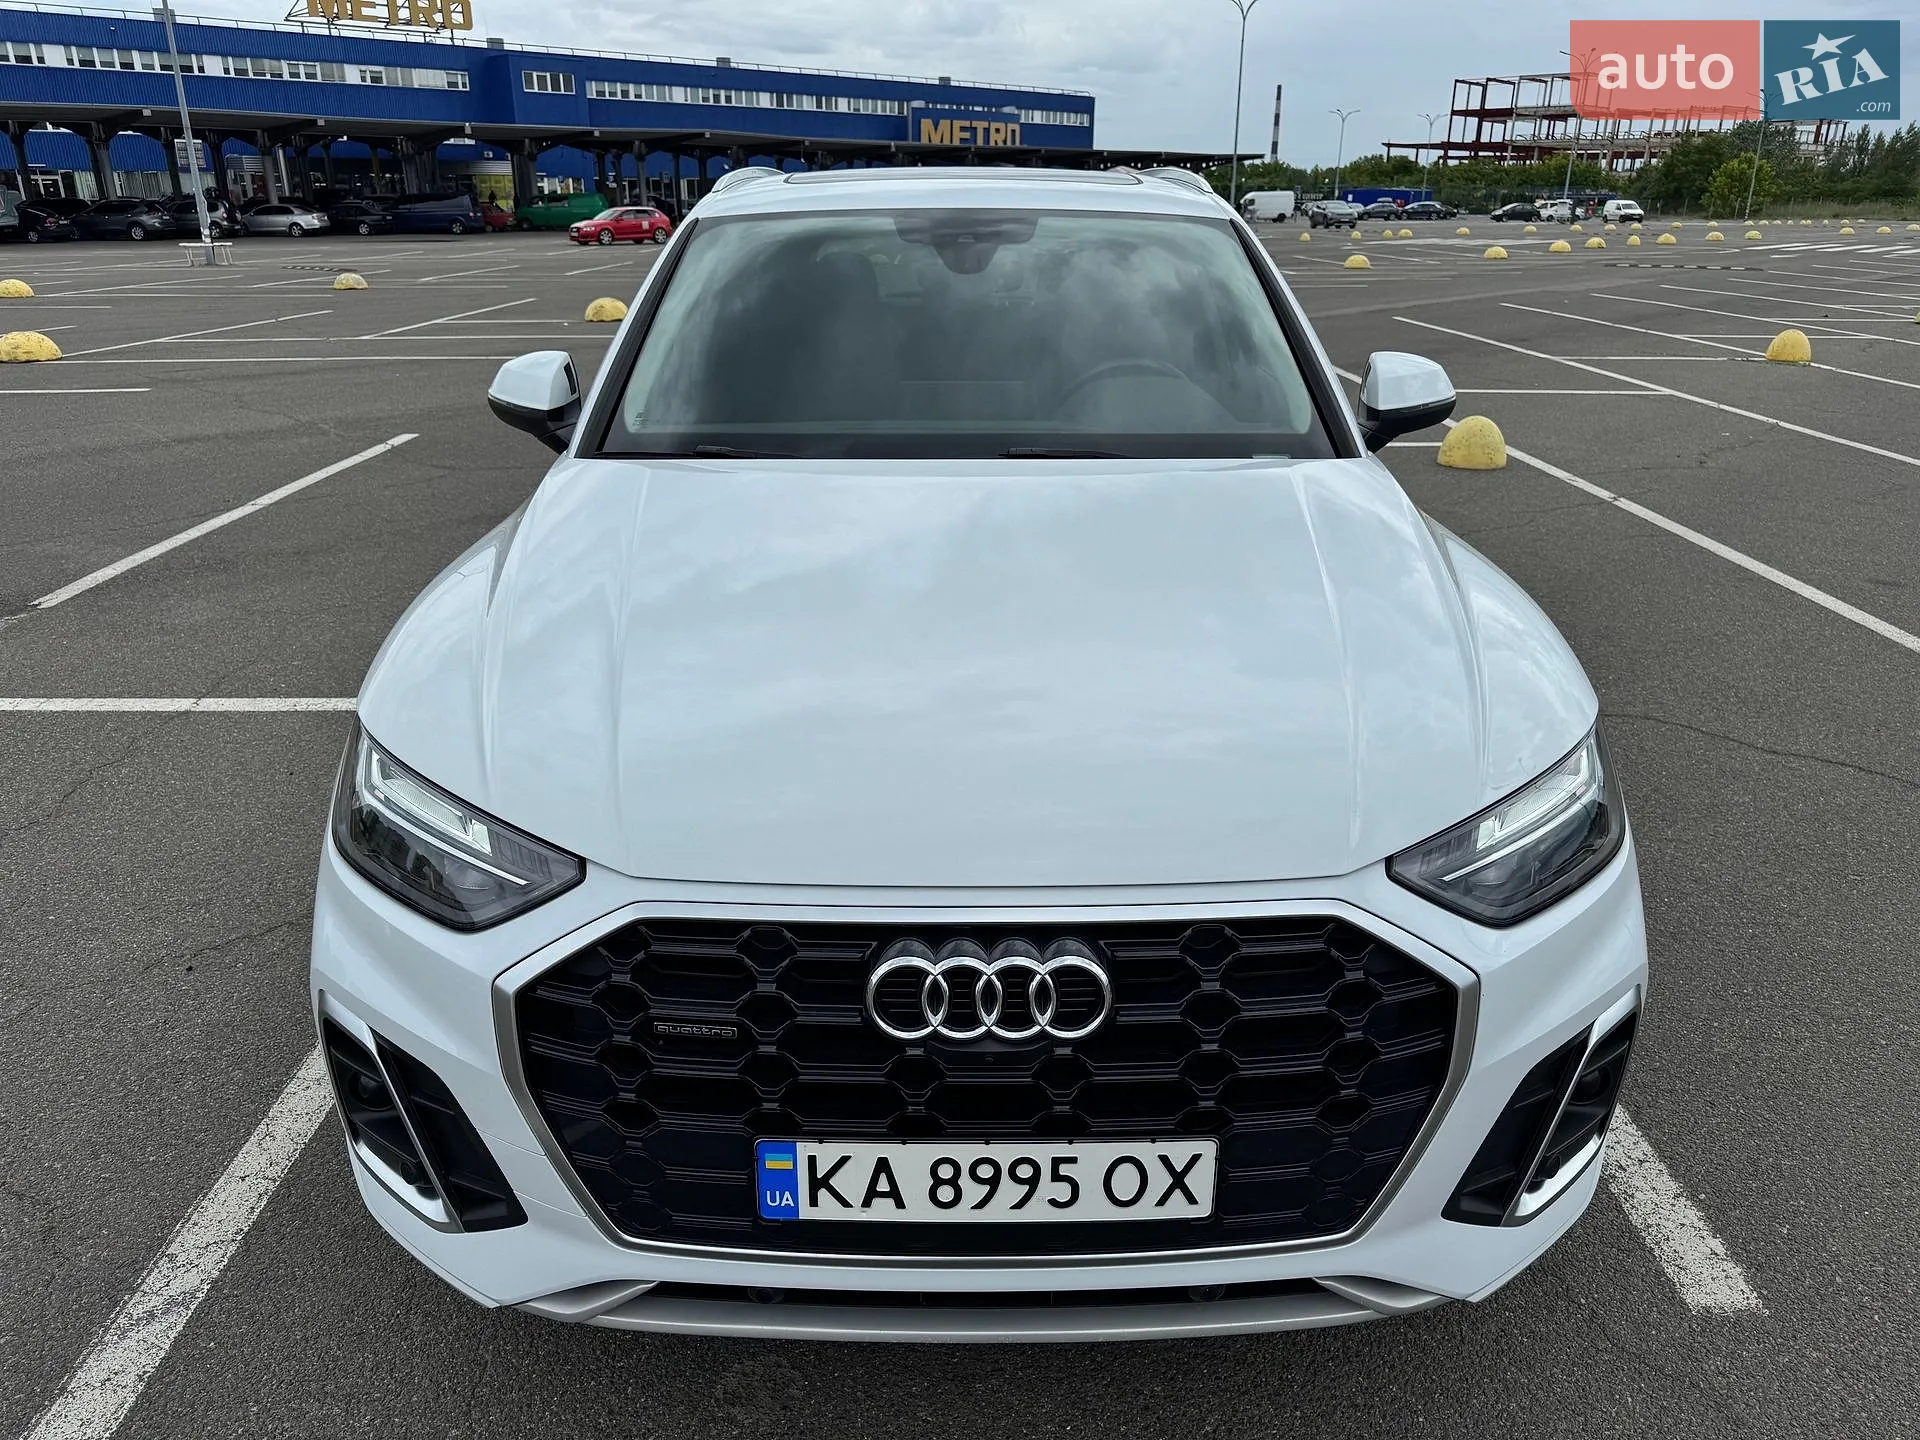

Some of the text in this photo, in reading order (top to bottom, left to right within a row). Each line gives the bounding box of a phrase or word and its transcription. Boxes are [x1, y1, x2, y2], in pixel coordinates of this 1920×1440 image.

[920, 118, 1021, 147] METRO
[657, 1025, 733, 1036] quattro
[807, 1153, 1203, 1210] KA 8995 OX
[766, 1190, 795, 1208] UA
